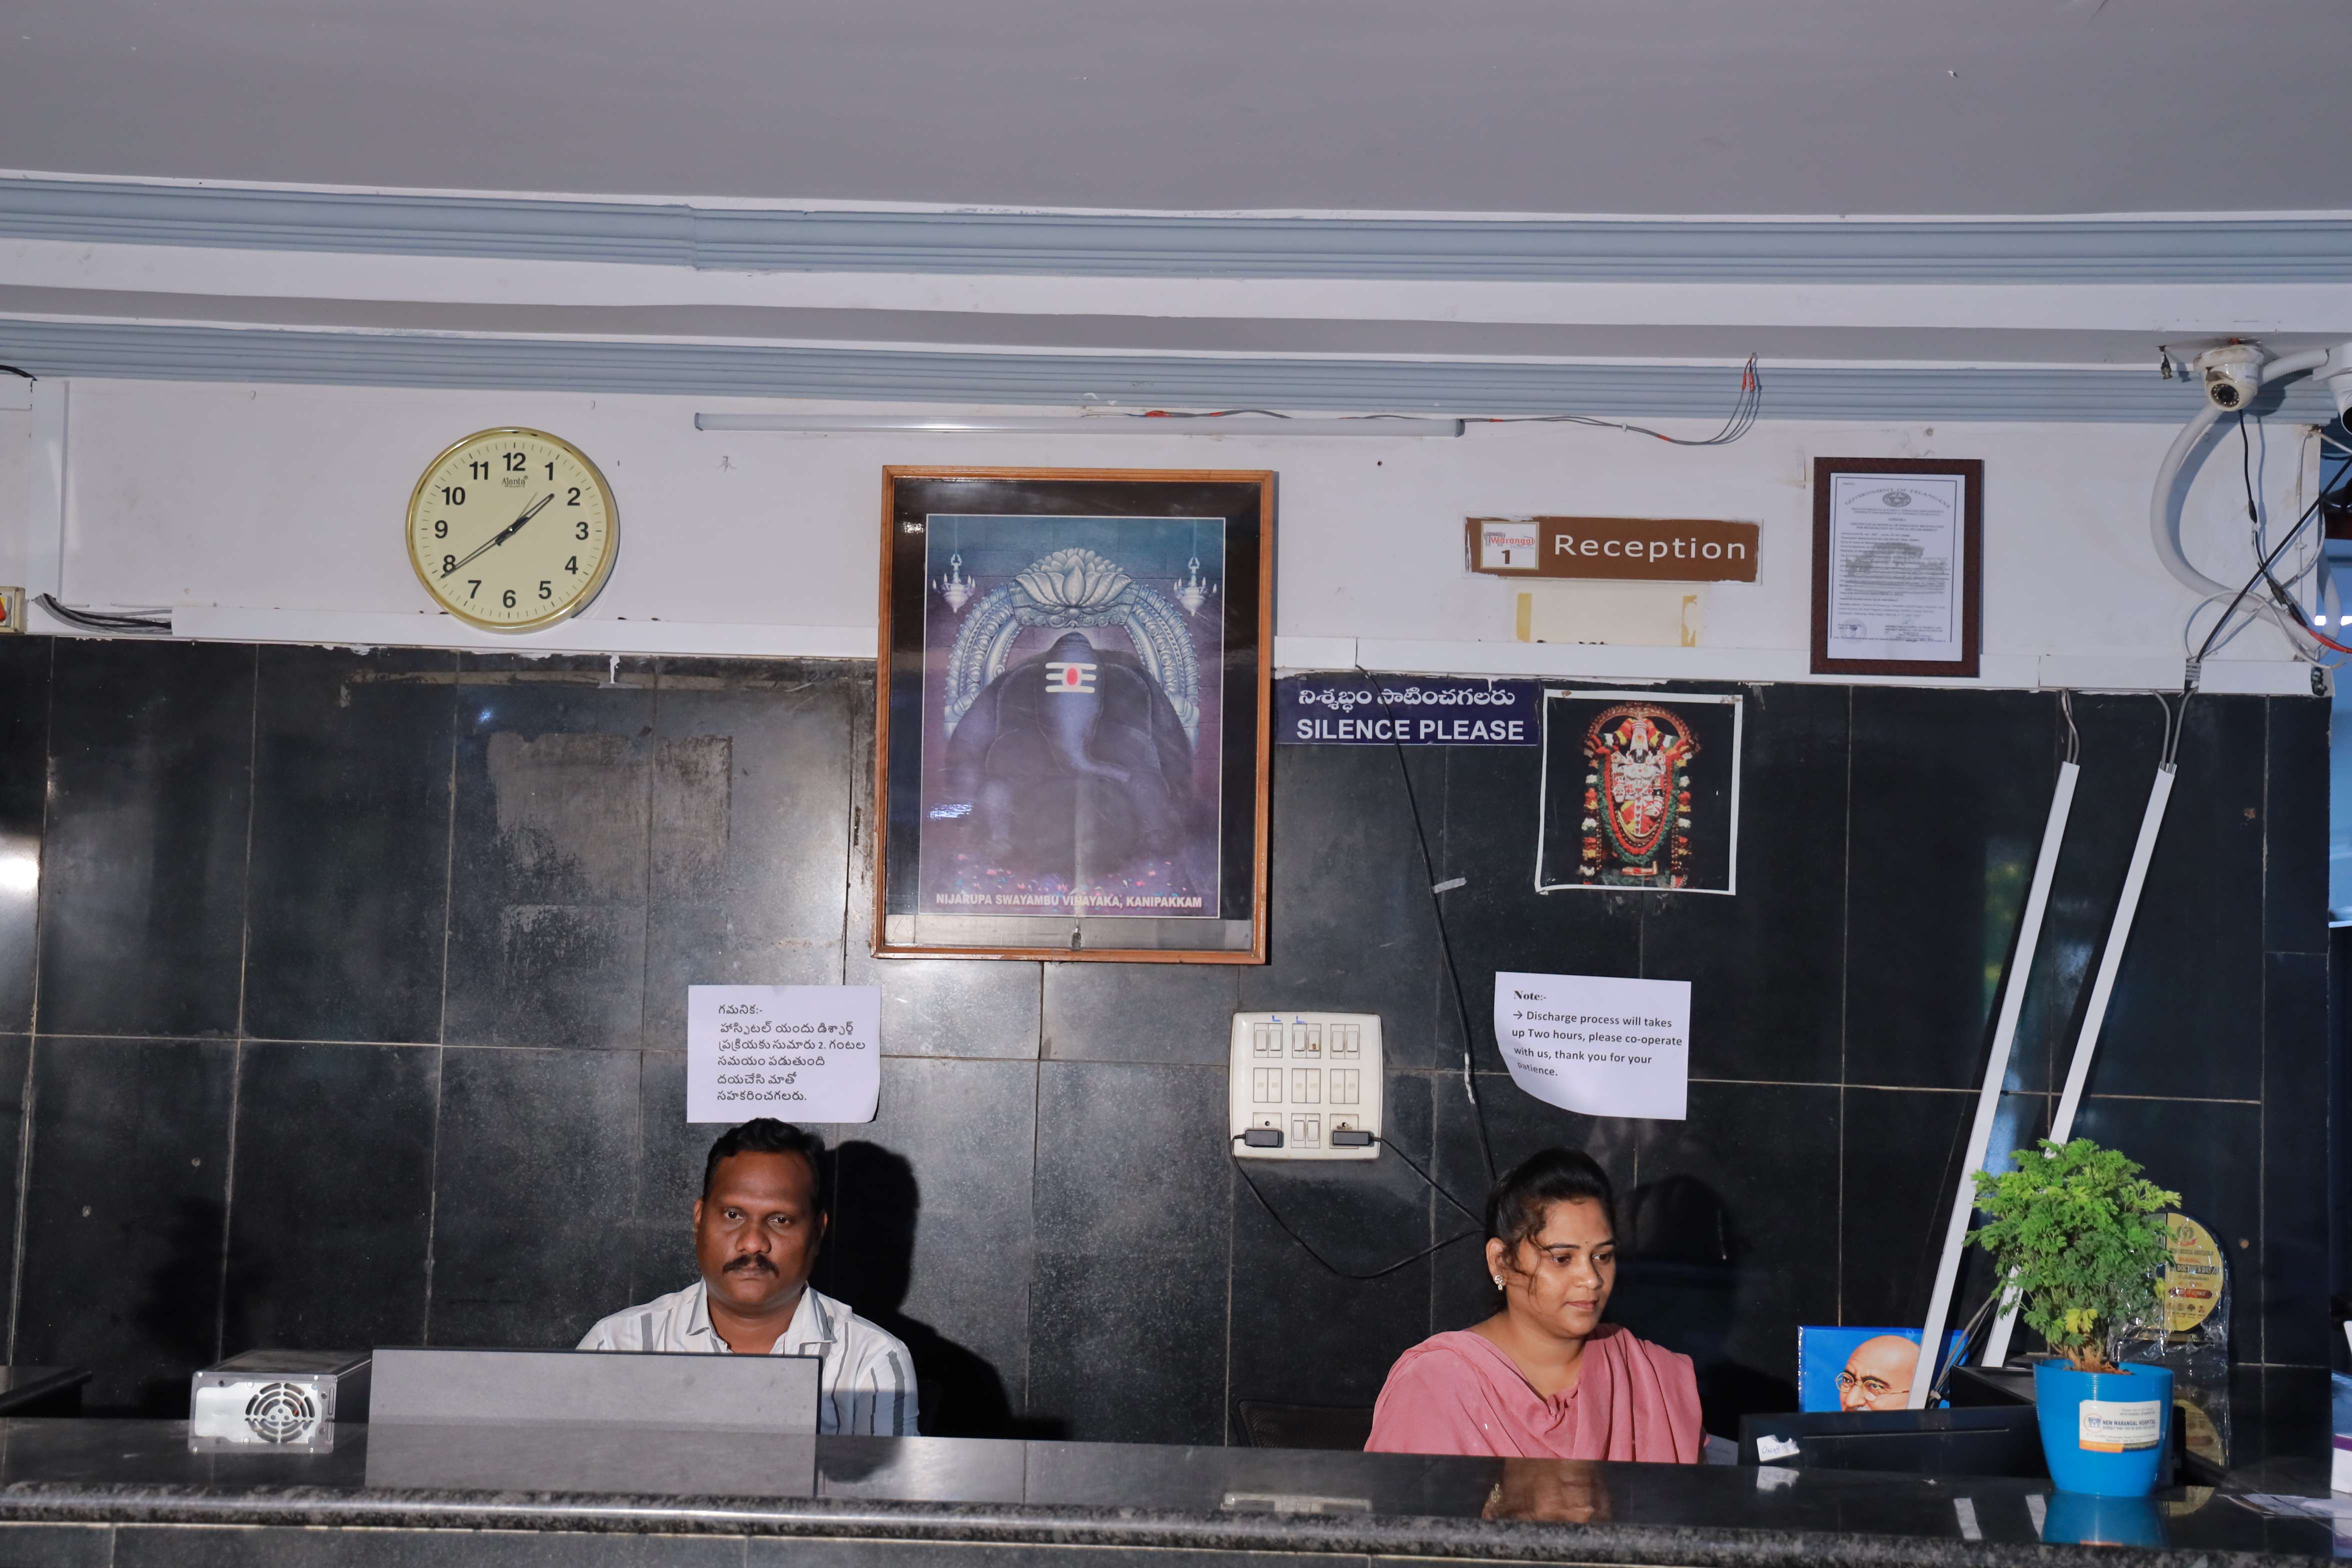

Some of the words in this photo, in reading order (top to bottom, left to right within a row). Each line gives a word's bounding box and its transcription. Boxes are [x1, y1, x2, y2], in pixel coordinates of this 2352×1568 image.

[503, 452, 526, 471] 12
[470, 462, 488, 480] 11
[545, 462, 553, 480] 1
[502, 478, 525, 487] Ajanta
[442, 487, 465, 505] 10
[568, 488, 580, 506] 2
[435, 520, 448, 538] 9
[576, 522, 588, 540] 3
[1502, 550, 1510, 564] 1
[1556, 535, 1744, 562] Reception
[443, 554, 456, 573] 8
[565, 556, 578, 574] 4
[468, 580, 482, 598] 7
[539, 581, 552, 599] 5
[503, 590, 516, 608] 6
[1296, 719, 1410, 740] SILENCE
[1420, 720, 1524, 740] PLEASE
[936, 894, 992, 904] NIJARUPA
[996, 894, 1058, 906] SWAYAMBU
[1126, 896, 1202, 908] KANIPAKKAM
[1514, 991, 1546, 1000] Note:-
[719, 1004, 762, 1014] గమనిక:-
[776, 1024, 814, 1032] యందు
[1528, 1012, 1576, 1024] Discharge
[1623, 1017, 1640, 1025] will
[1644, 1018, 1672, 1027] takes
[773, 1040, 815, 1049] సుమారు
[830, 1040, 865, 1049] గంటల
[1512, 1030, 1524, 1038] up
[1528, 1029, 1550, 1038] Two
[1554, 1030, 1584, 1041] hours,
[1589, 1032, 1622, 1042] please
[1626, 1036, 1682, 1046] co-operate
[718, 1056, 765, 1065] సమయం
[769, 1056, 824, 1066] పడుతుంది
[1514, 1048, 1534, 1056] with
[1556, 1050, 1584, 1060] thank
[1610, 1053, 1624, 1062] for
[1518, 1062, 1557, 1076] patience.
[718, 1073, 764, 1084] దయచేసి
[768, 1072, 796, 1084] మాతో
[718, 1090, 806, 1100] సహకరించగలరు.
